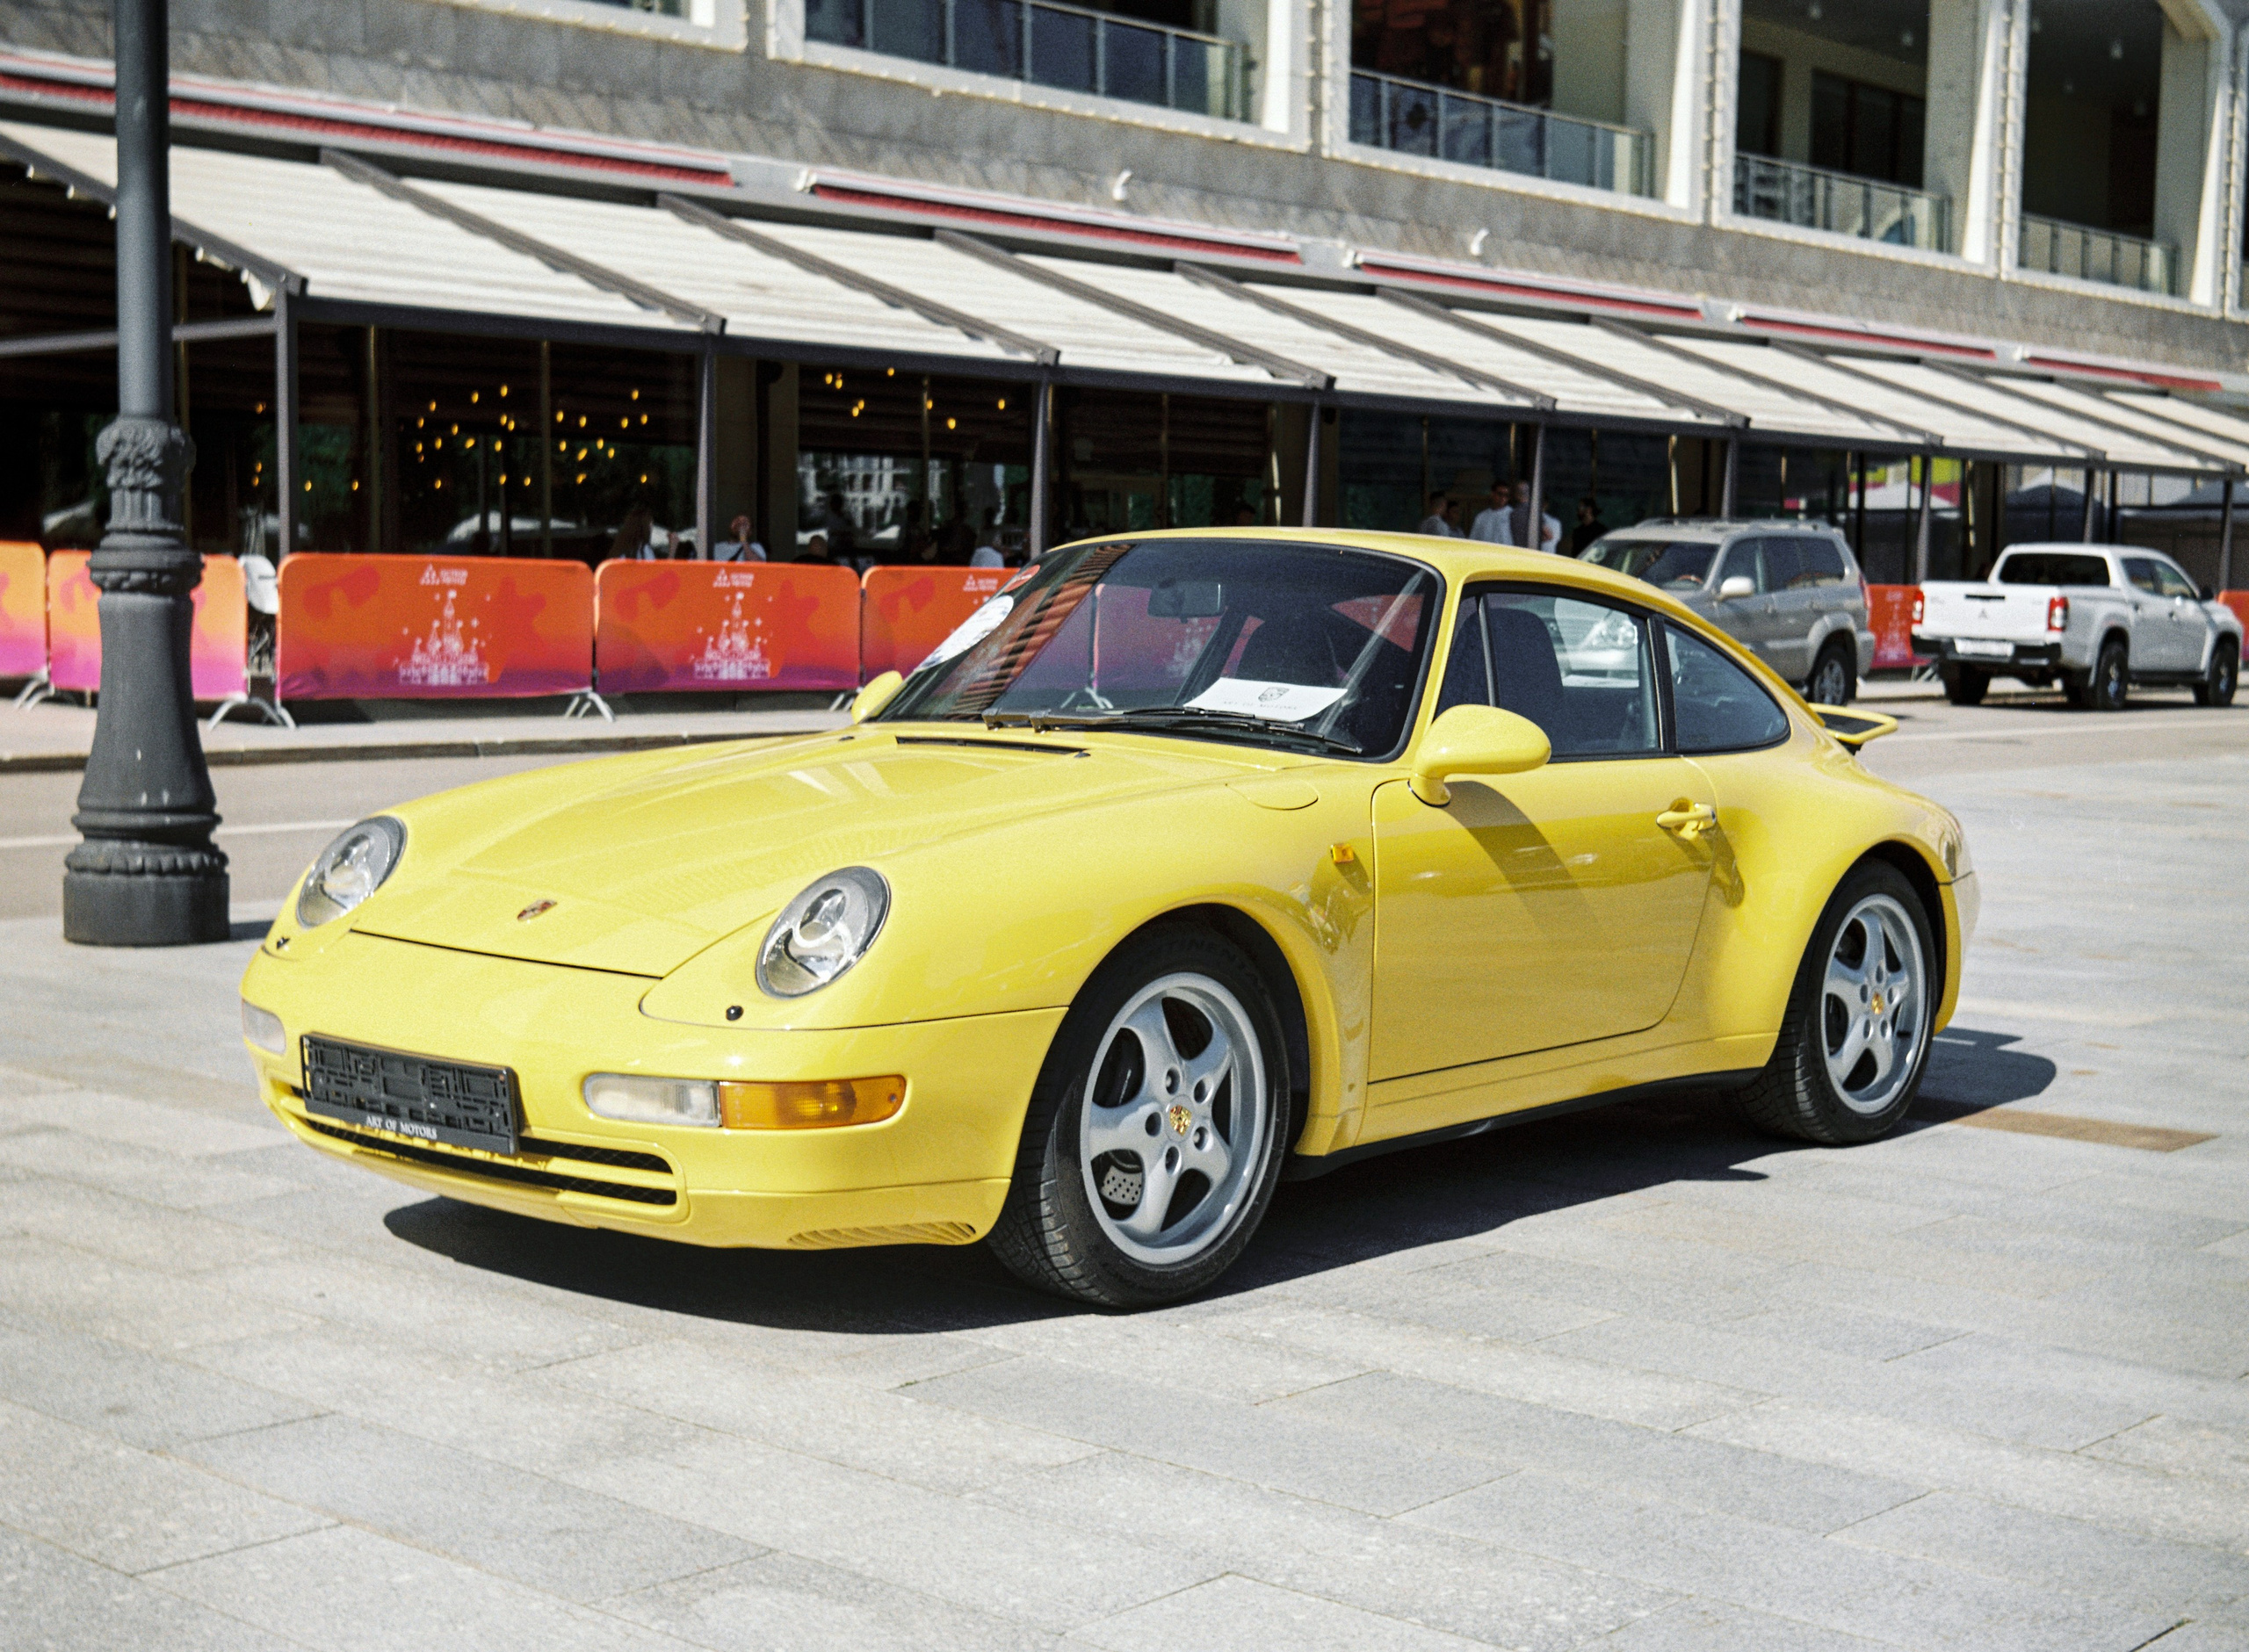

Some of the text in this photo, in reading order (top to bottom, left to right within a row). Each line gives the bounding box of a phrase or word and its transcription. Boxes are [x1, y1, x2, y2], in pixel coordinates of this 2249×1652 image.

[365, 1115, 438, 1140] ART OF MOTORS
